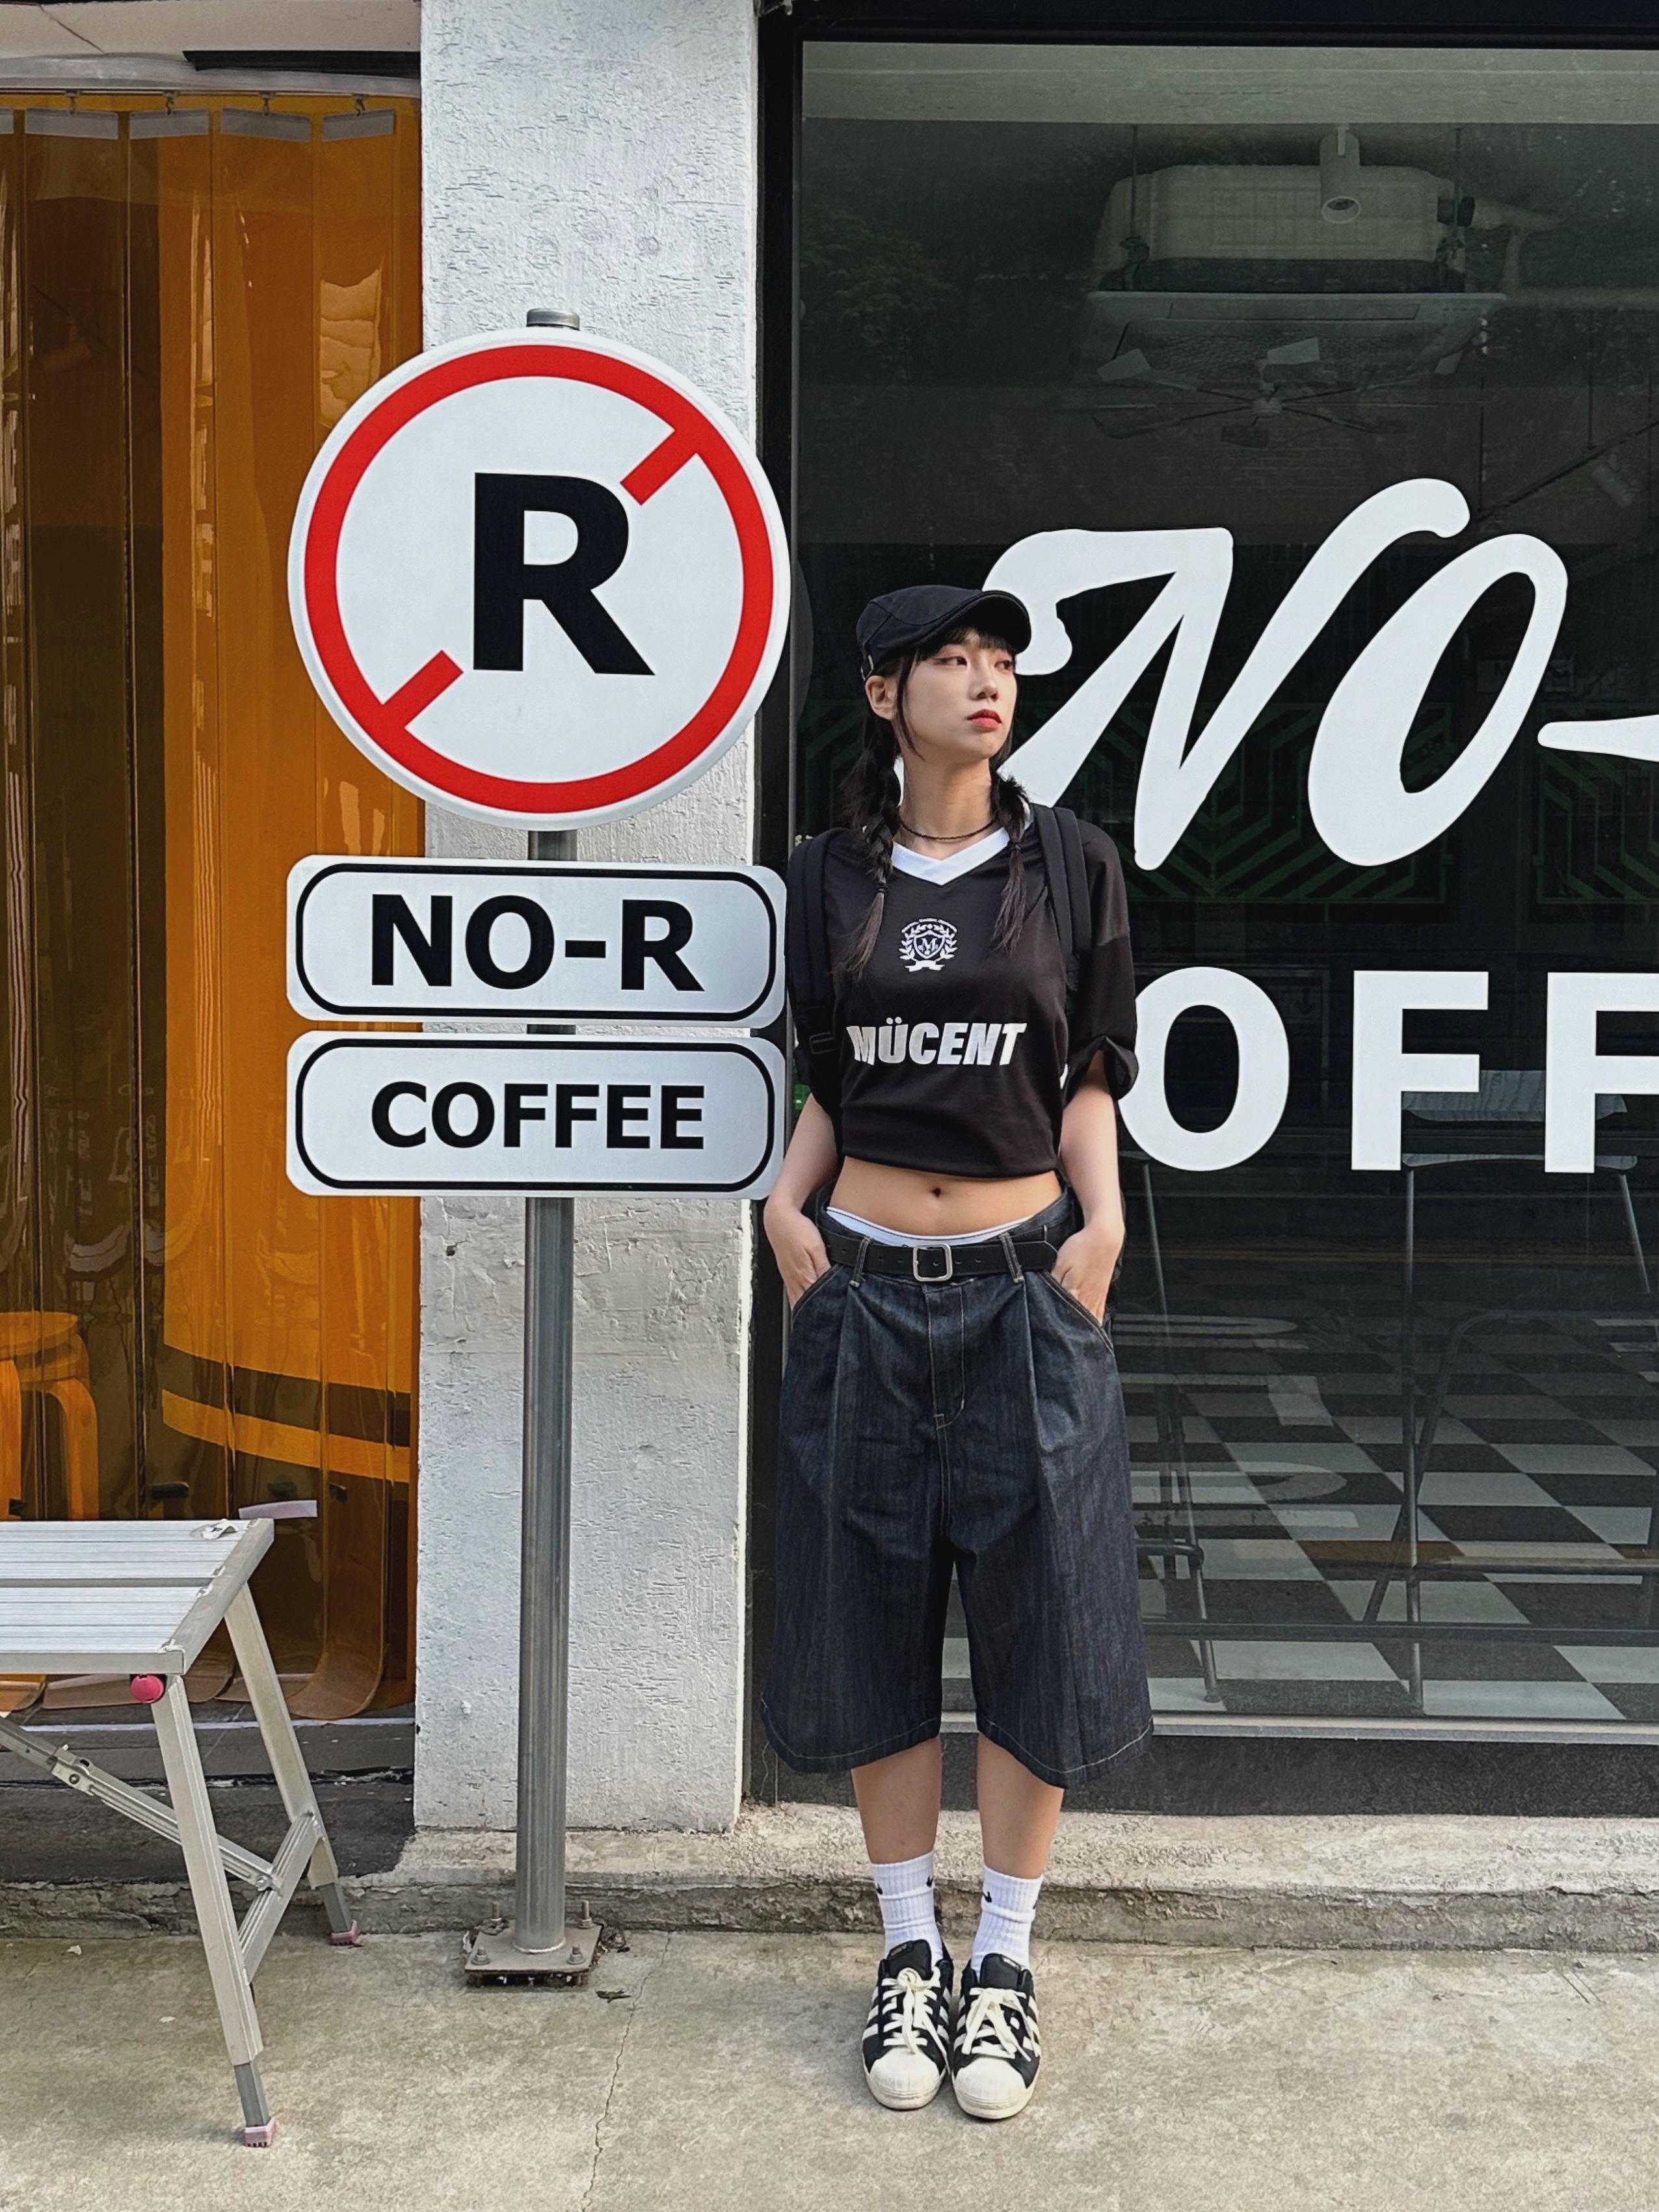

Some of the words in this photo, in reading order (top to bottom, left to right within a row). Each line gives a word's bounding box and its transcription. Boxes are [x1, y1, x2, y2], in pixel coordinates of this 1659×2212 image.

[473, 472, 655, 676] R
[371, 894, 705, 992] NO-R
[846, 1016, 1028, 1066] MÜCENT
[371, 1081, 704, 1150] COFFEE
